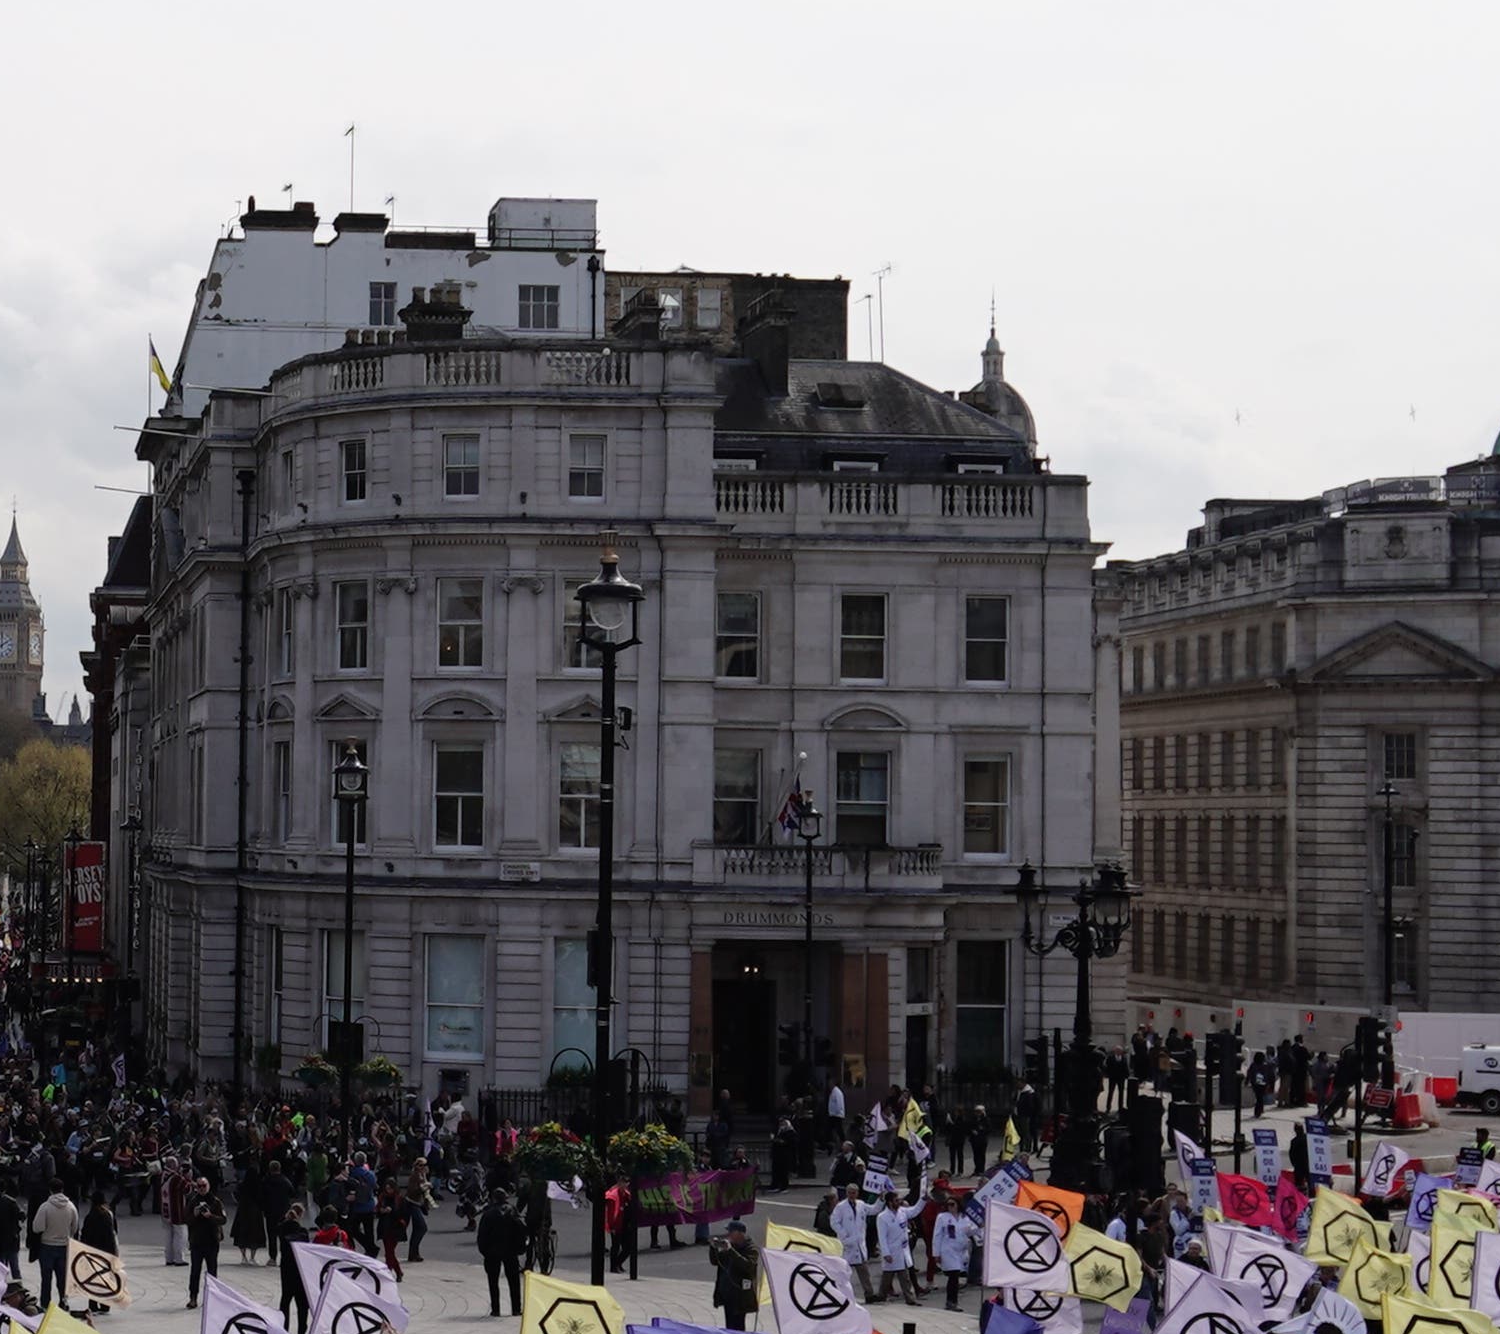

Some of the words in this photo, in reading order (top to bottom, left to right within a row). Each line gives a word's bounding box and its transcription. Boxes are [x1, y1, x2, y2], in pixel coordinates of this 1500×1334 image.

[65, 865, 104, 886] JRSEY
[74, 883, 101, 905] OYS
[132, 854, 141, 949] Theatre
[724, 913, 835, 926] DRUMMONDS
[47, 965, 79, 977] JERSY
